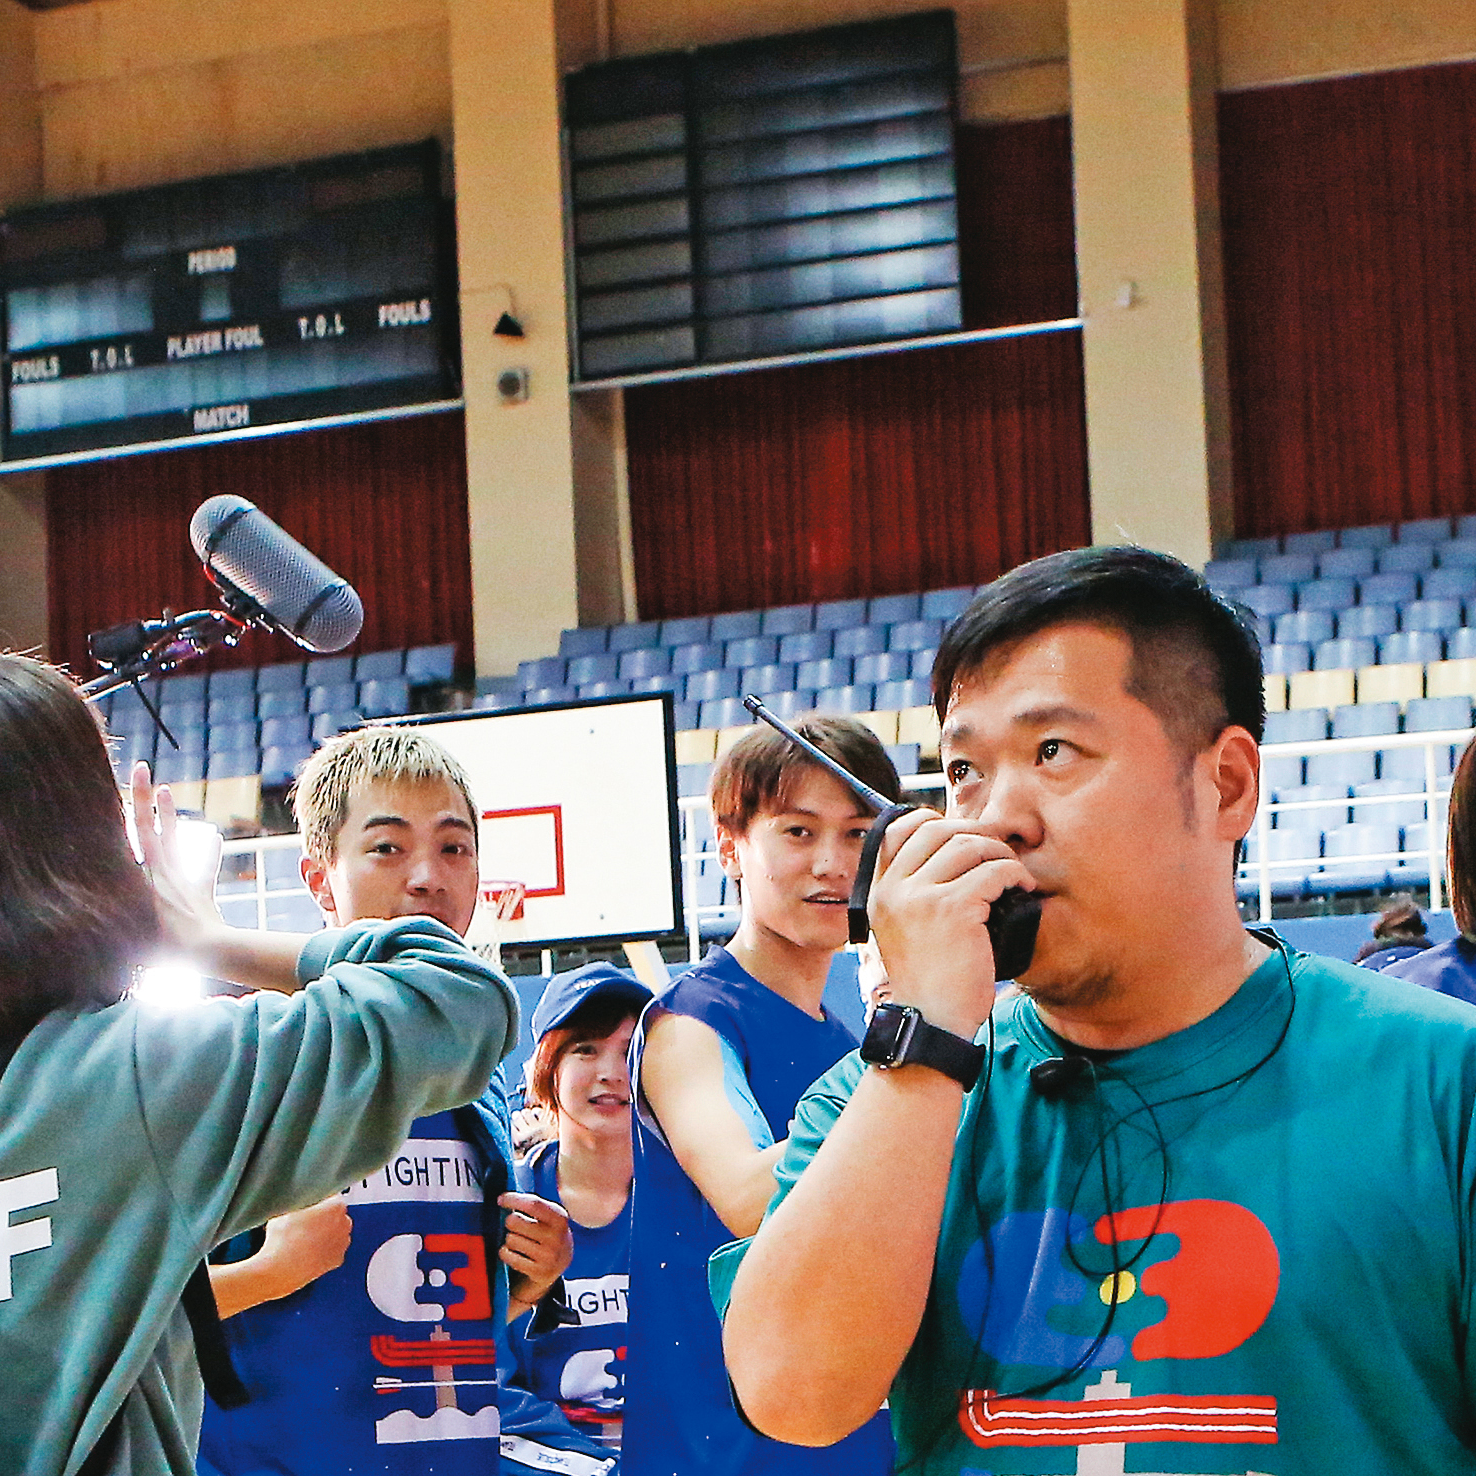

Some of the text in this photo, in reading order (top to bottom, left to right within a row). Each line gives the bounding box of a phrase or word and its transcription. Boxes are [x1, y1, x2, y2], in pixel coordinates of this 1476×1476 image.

[187, 245, 237, 274] PERIOD
[378, 298, 431, 328] FOULS
[166, 324, 264, 360] PLAYER FOUL
[11, 355, 60, 384] FOULS
[193, 402, 250, 434] MATCH
